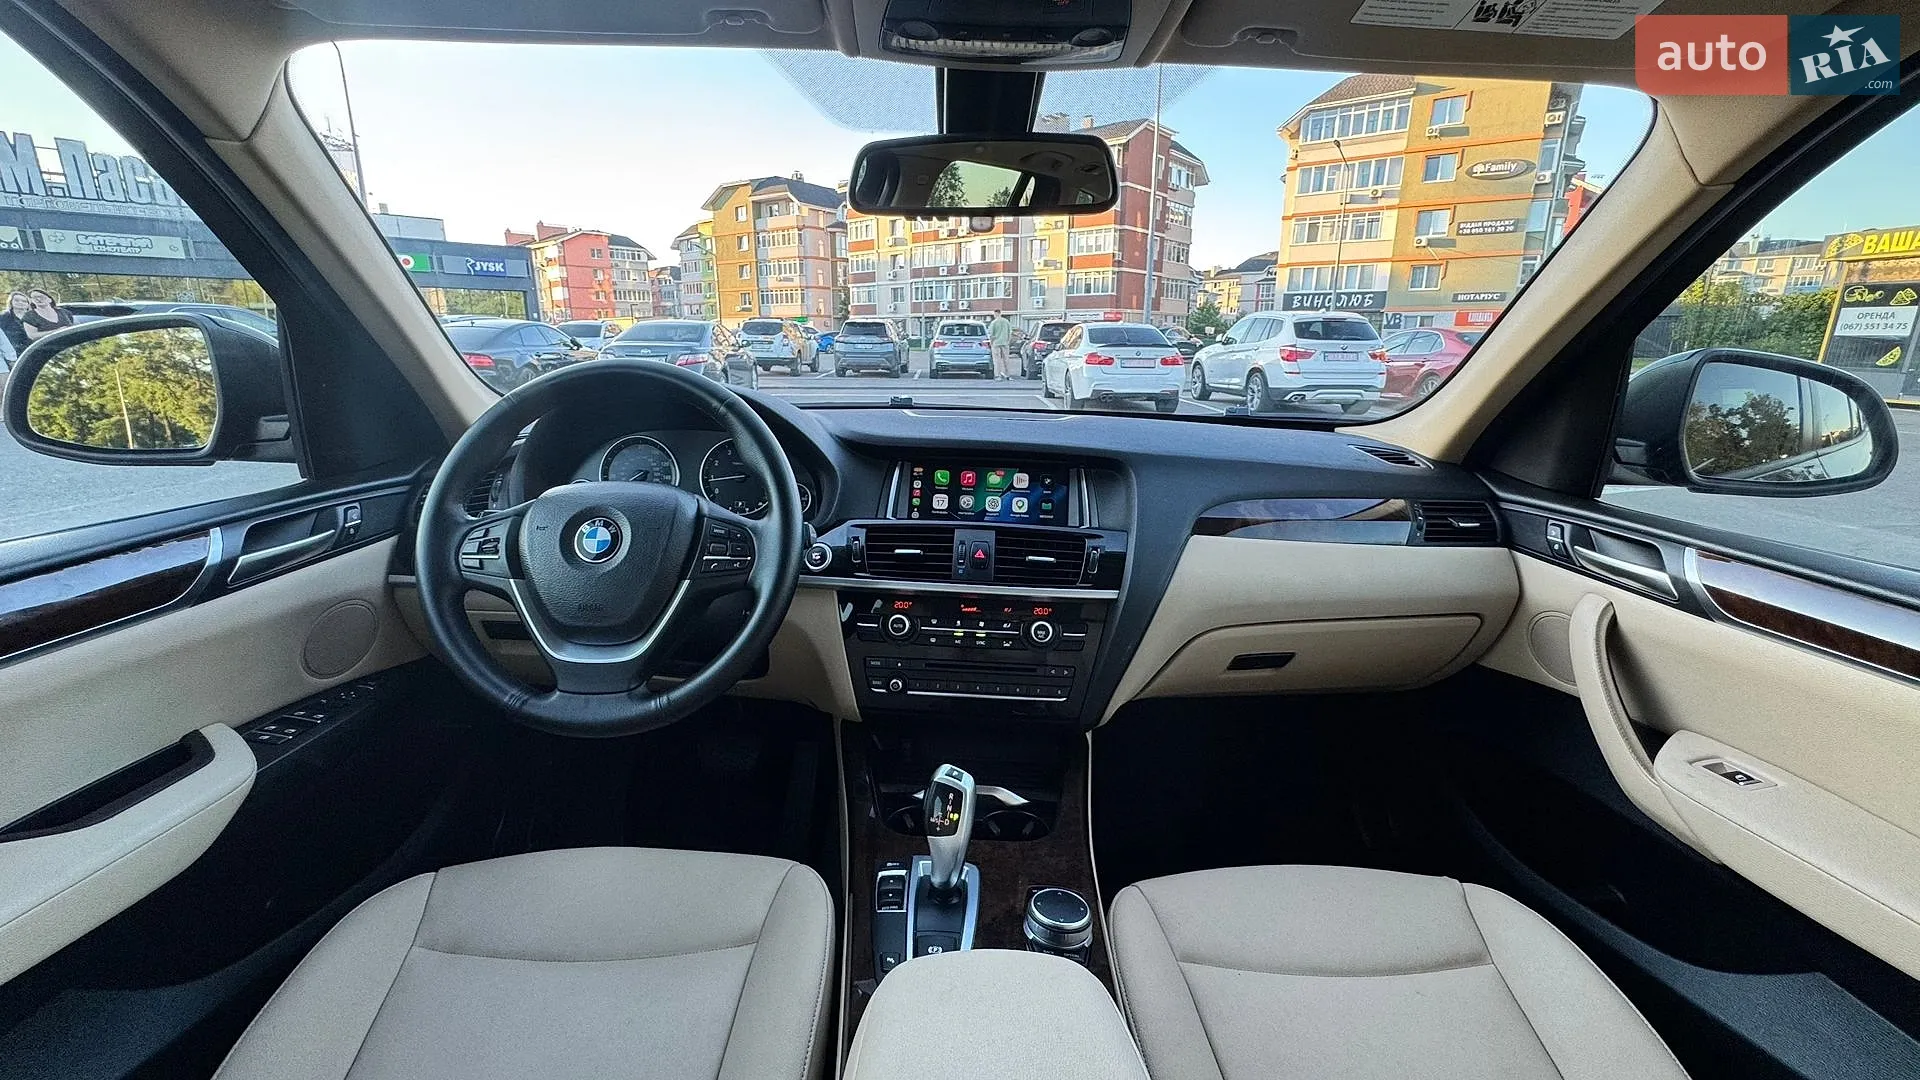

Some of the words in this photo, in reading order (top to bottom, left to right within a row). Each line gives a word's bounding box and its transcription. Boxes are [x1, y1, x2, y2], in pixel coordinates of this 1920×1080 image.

[1485, 161, 1518, 172] Family
[1483, 219, 1515, 228] ПРОДАЖУ
[474, 261, 505, 273] JYSK
[1457, 293, 1501, 301] НОТАРІУС
[1857, 312, 1896, 320] ОРЕНДА
[1840, 322, 1863, 331] (067)
[1863, 322, 1880, 330] 551
[1882, 322, 1894, 330] 34
[1895, 322, 1908, 330] 75
[581, 519, 617, 534] BMW
[948, 792, 954, 800] R
